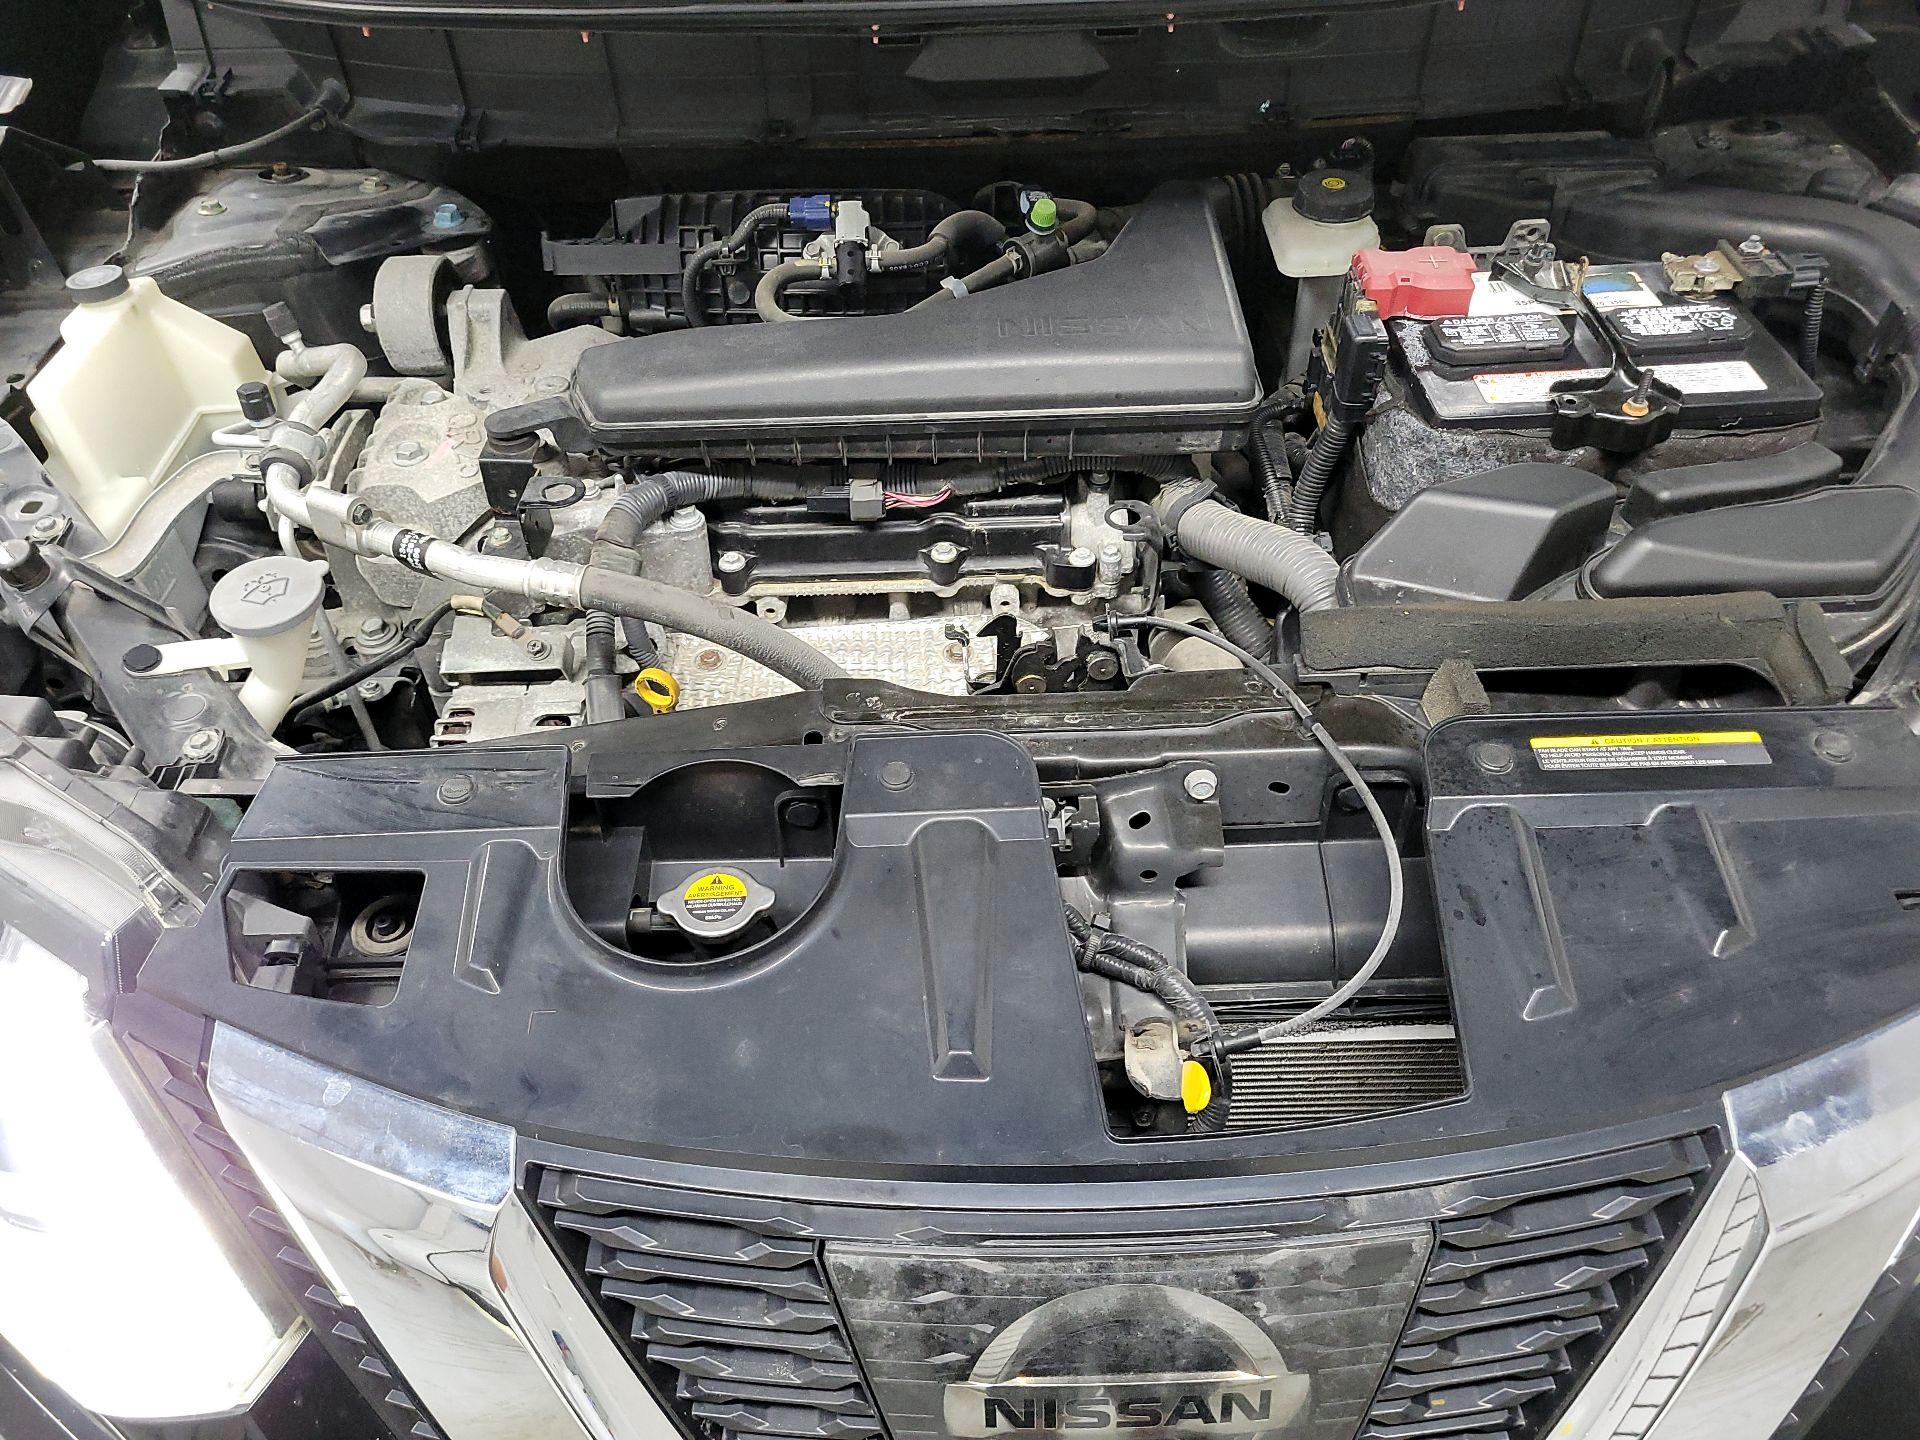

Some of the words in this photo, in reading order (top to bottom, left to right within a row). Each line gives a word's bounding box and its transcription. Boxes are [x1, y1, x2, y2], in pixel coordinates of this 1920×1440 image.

[697, 884, 735, 892] WARNING
[687, 890, 743, 899] AVERTISSEMENT
[984, 1389, 1272, 1430] NISSAN
